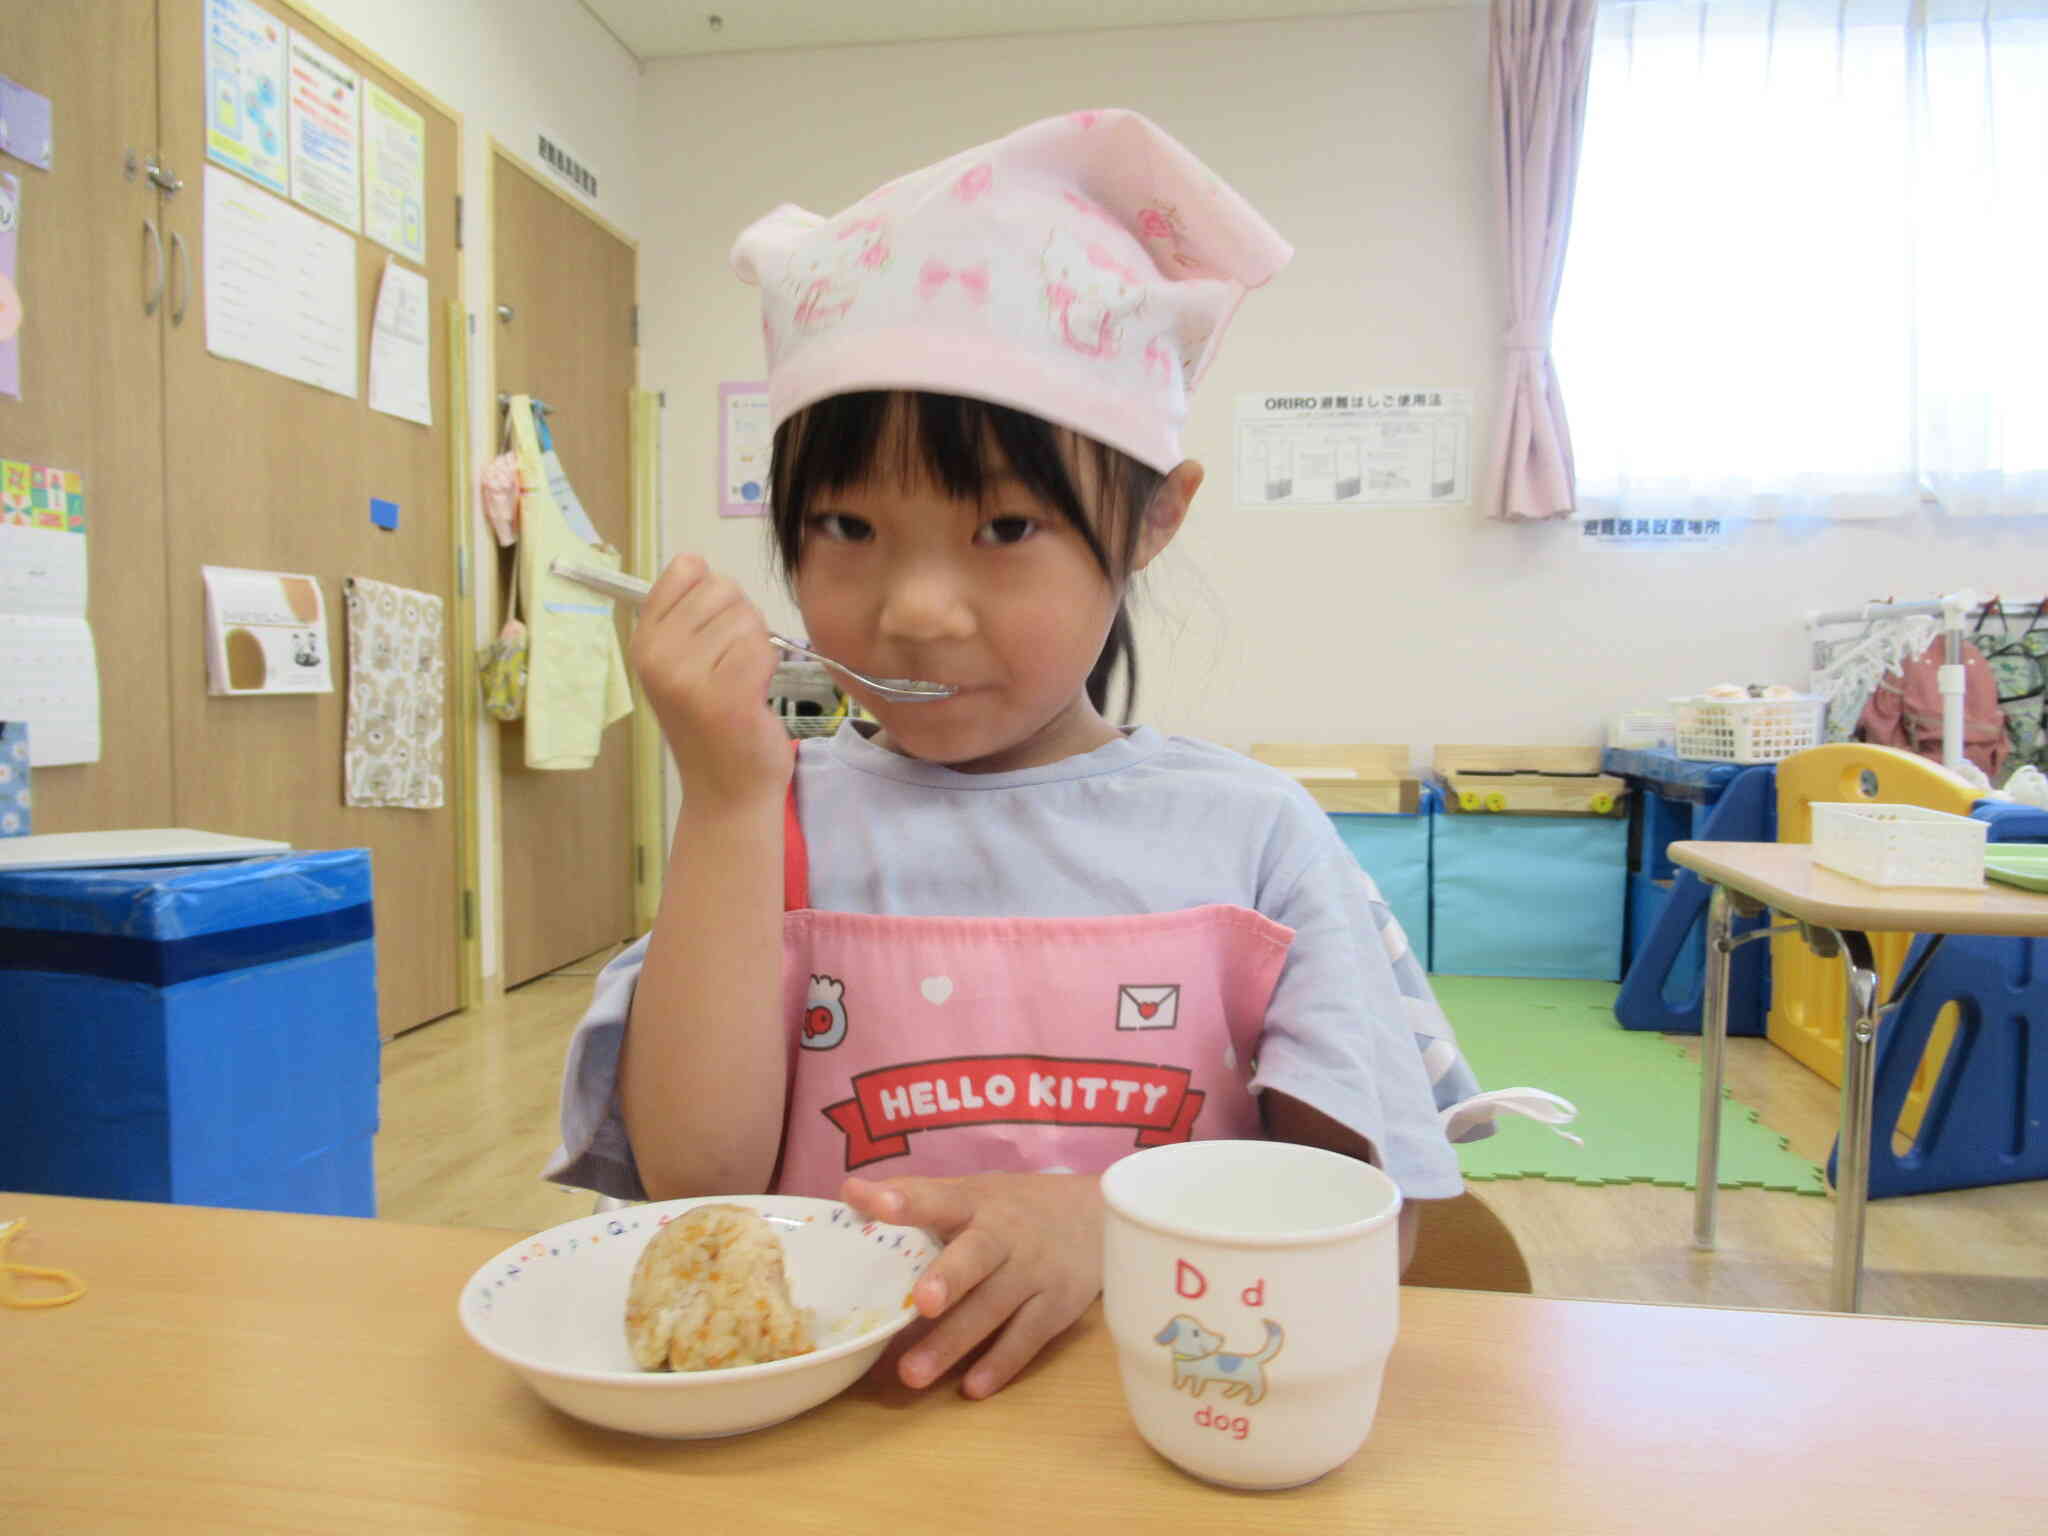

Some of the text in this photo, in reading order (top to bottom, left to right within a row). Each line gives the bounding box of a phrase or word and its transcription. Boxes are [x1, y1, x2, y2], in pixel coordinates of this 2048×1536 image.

[1264, 397, 1317, 411] ORIRO
[880, 1072, 1168, 1121] HELLO KITTY
[1175, 1258, 1265, 1307] D d
[1193, 1406, 1250, 1440] dog
